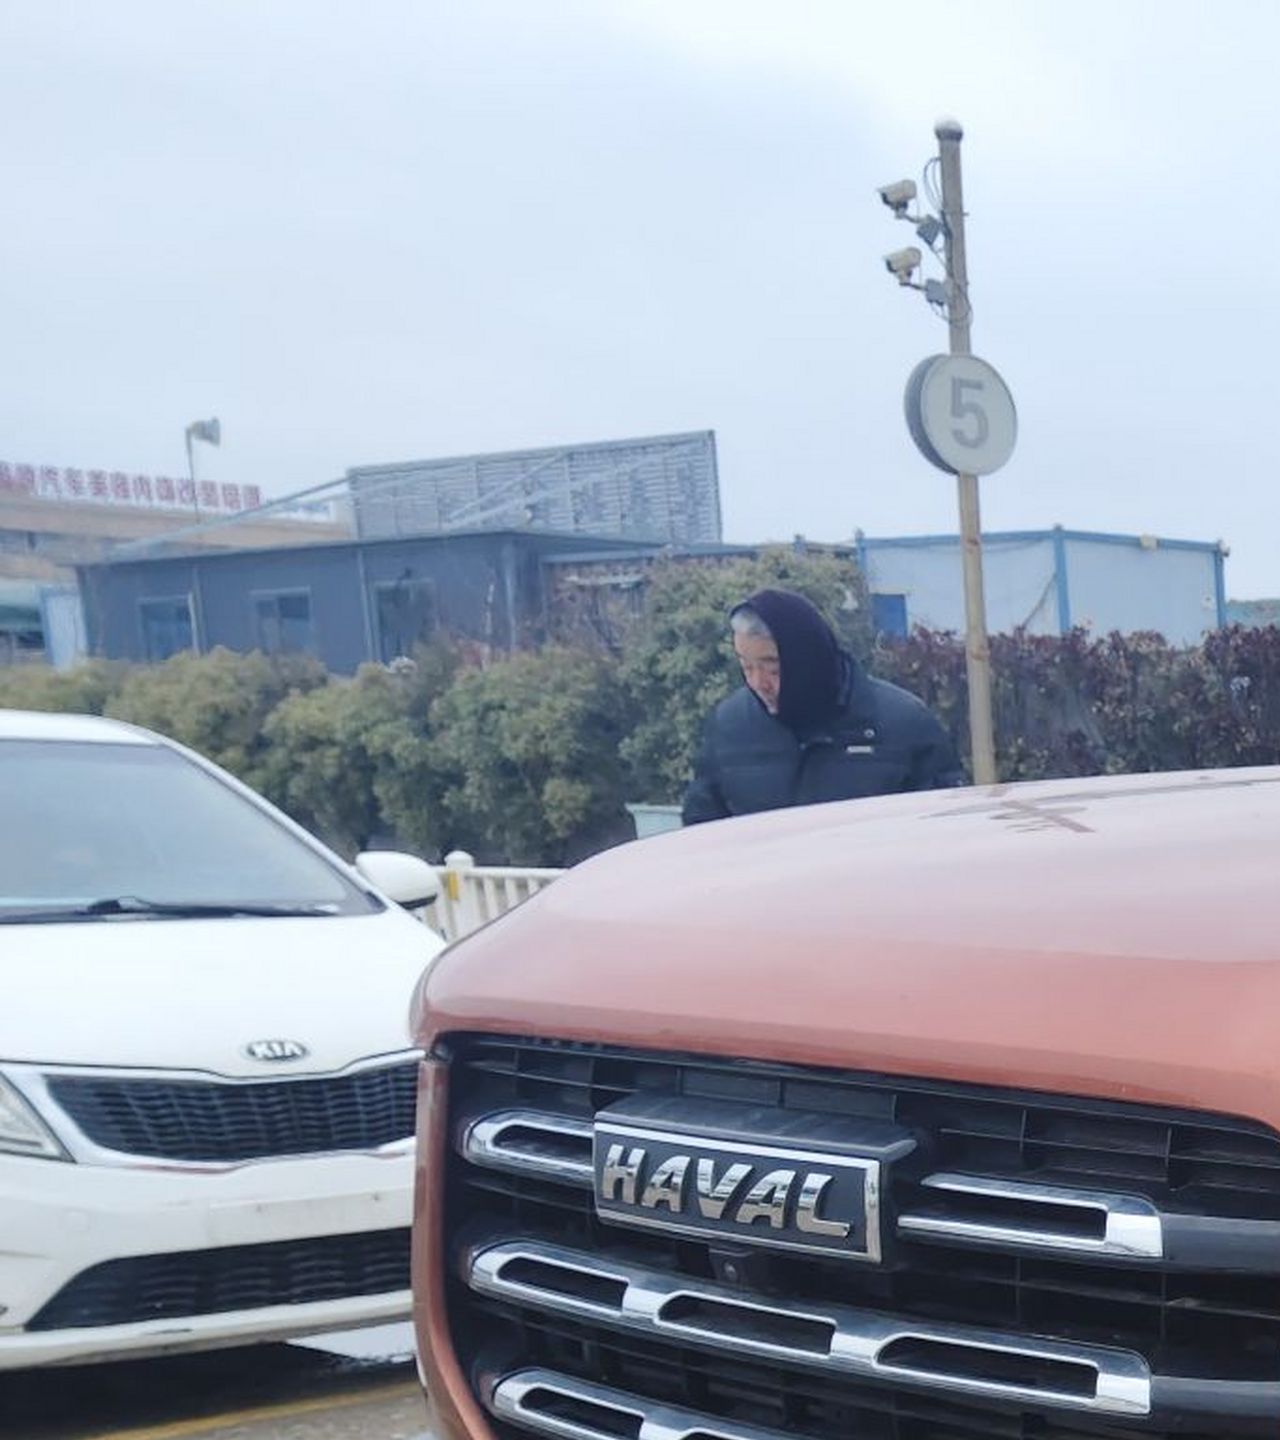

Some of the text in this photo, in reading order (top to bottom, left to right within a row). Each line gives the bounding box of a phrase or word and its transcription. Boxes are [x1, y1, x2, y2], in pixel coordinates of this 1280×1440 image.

[950, 376, 990, 450] 5
[253, 1041, 303, 1059] KIA
[601, 1143, 851, 1238] HAVAL
